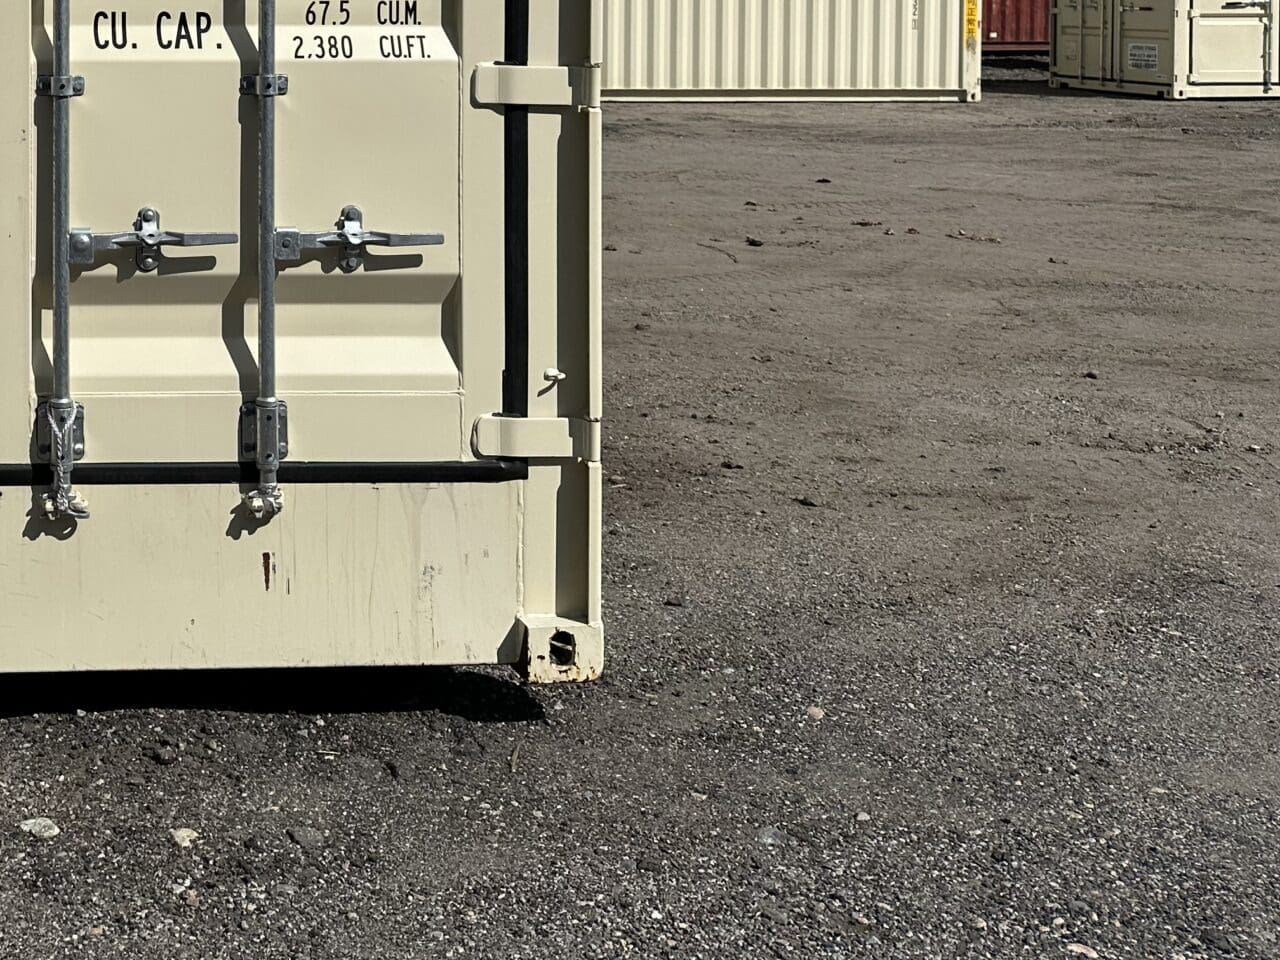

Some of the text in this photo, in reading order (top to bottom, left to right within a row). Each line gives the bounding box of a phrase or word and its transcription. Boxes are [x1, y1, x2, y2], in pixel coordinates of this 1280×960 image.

[93, 11, 138, 50] CU.
[156, 11, 223, 50] CAP.
[305, 0, 351, 25] 67.5
